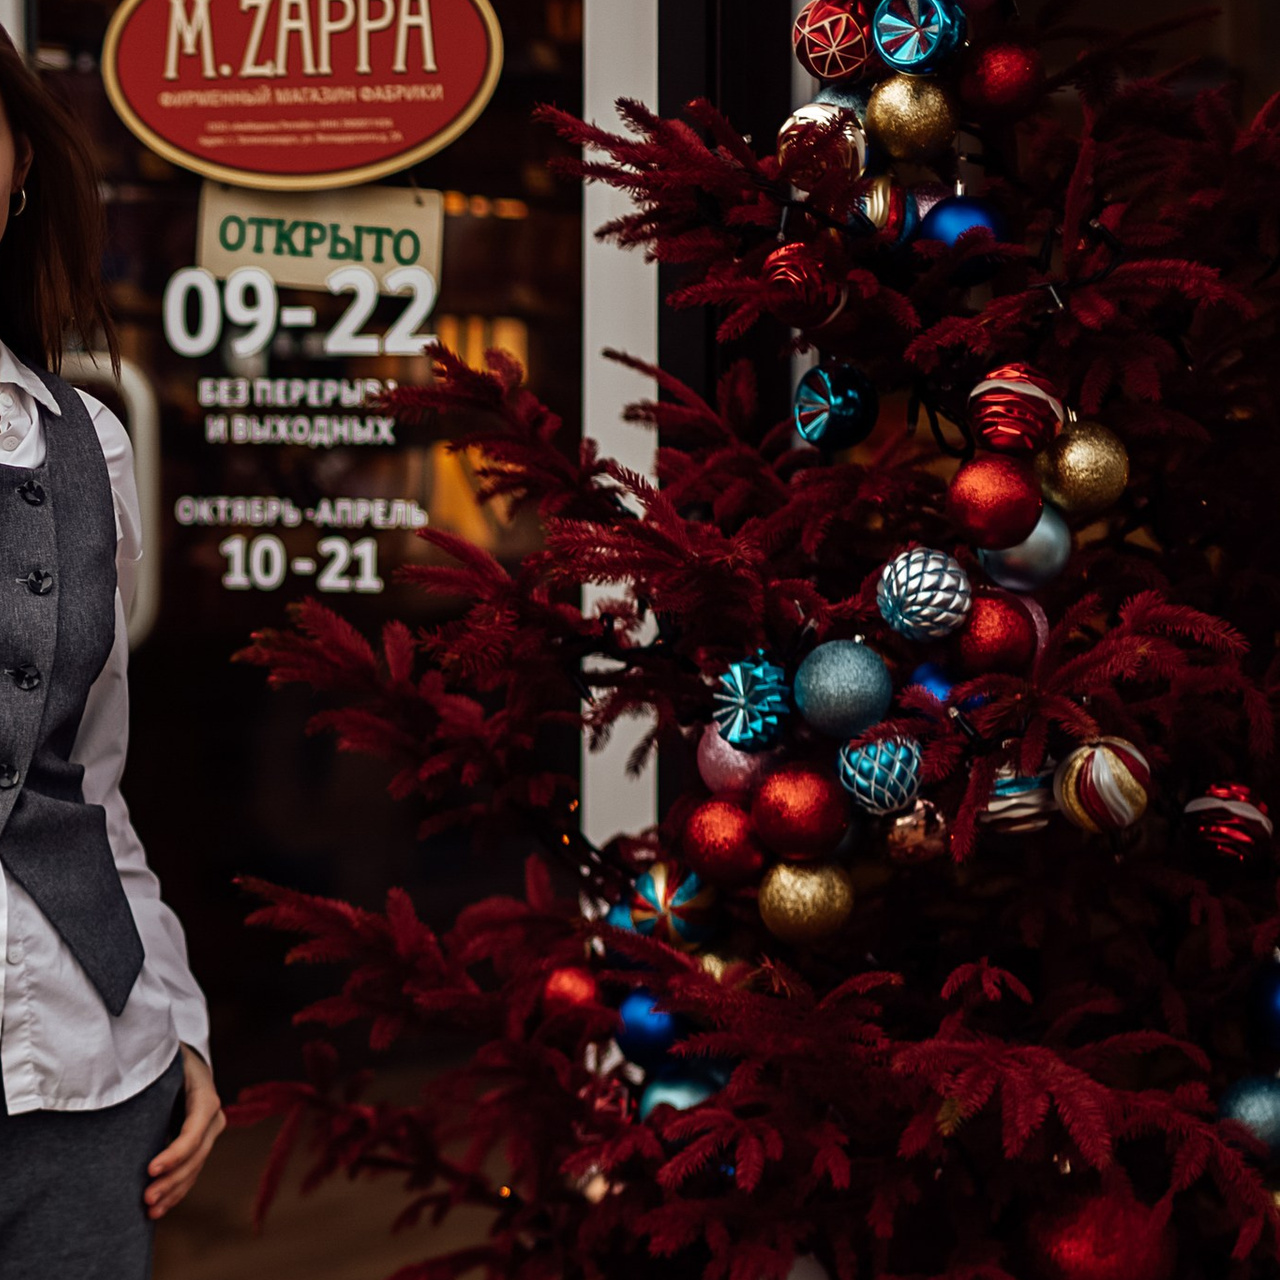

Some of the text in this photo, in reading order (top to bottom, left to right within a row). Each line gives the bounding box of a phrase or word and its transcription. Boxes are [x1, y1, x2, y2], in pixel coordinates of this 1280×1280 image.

[219, 214, 421, 266] ОТКРЫТО
[163, 265, 439, 358] 09-22
[199, 378, 398, 408] БЕЗ ПЕРЕРЫВ
[206, 414, 395, 448] И ВЫХОДНЫХ
